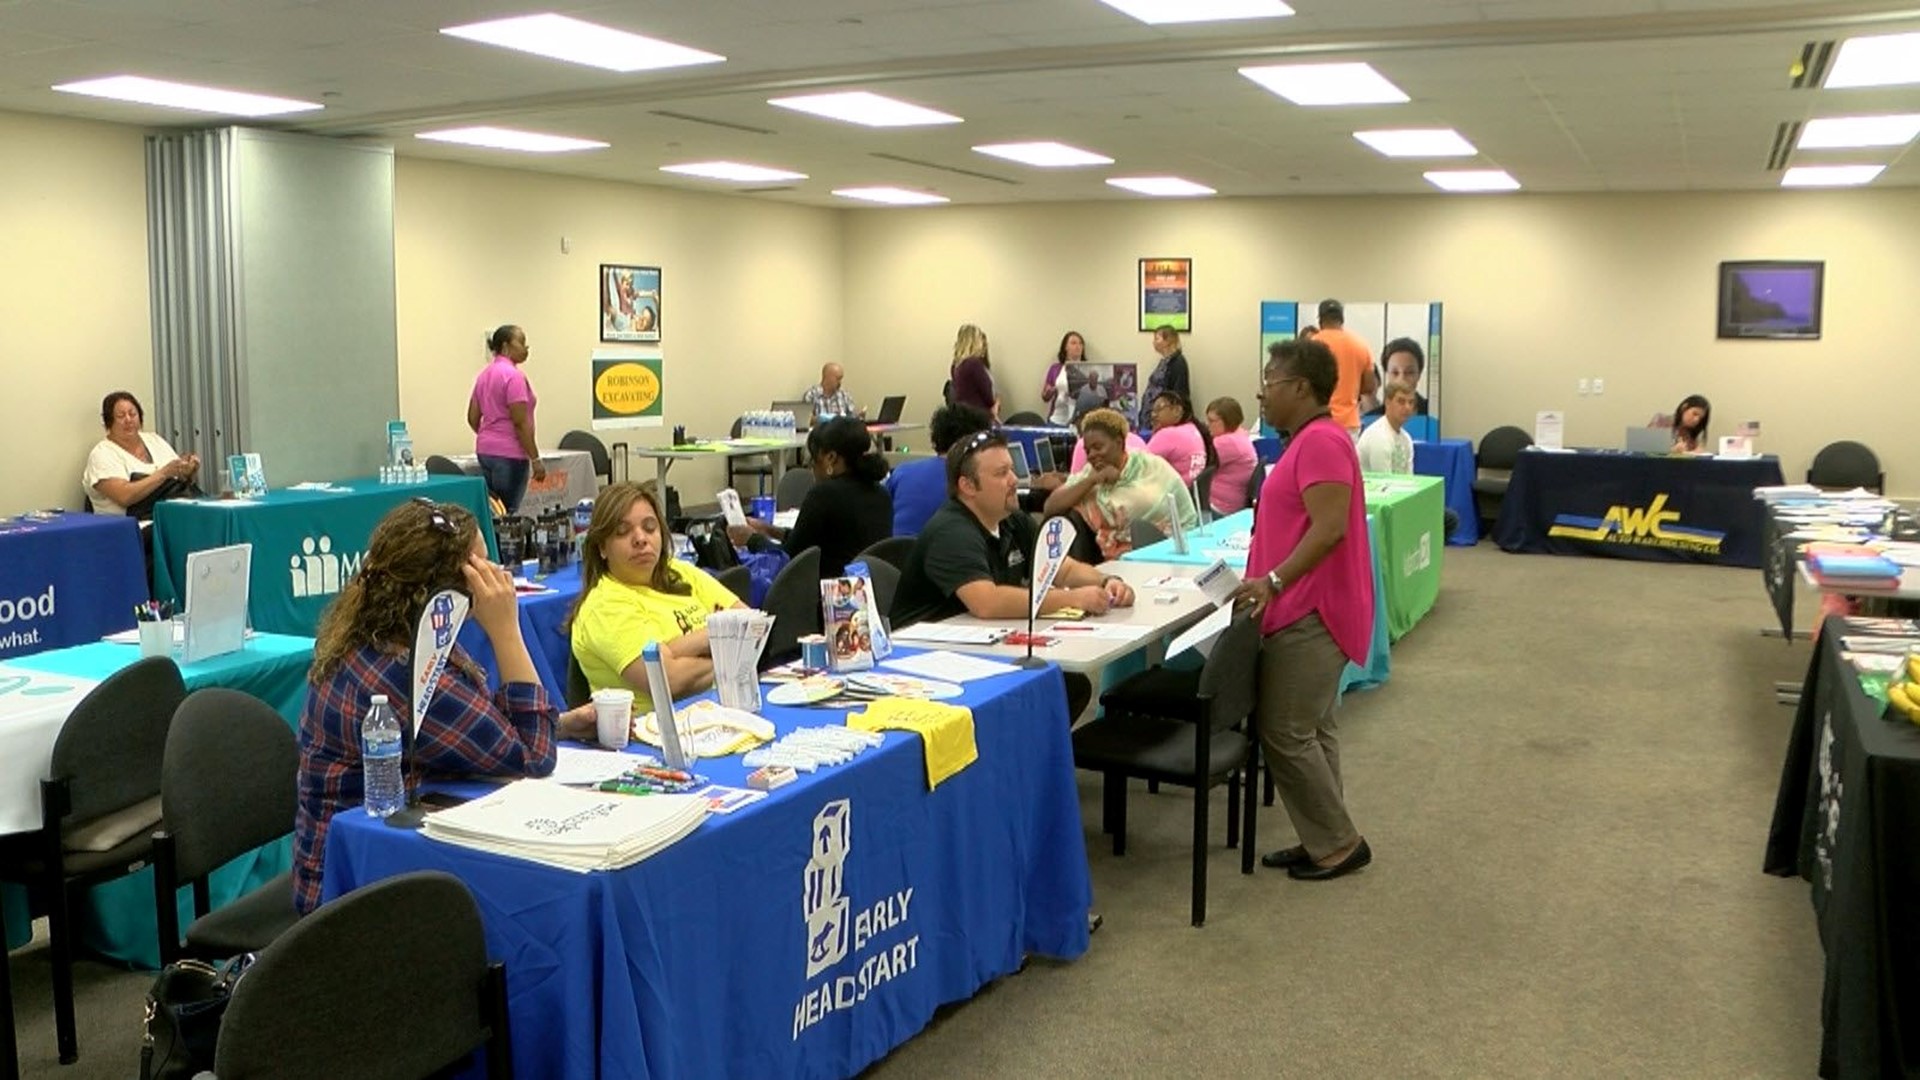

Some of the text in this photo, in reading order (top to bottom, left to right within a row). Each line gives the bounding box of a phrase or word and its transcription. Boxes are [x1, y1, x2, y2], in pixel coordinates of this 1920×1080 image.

[607, 375, 650, 387] ROBINSON
[602, 391, 655, 404] EXCAVATING
[1598, 493, 1681, 540] AWC
[855, 888, 913, 951] EARLY
